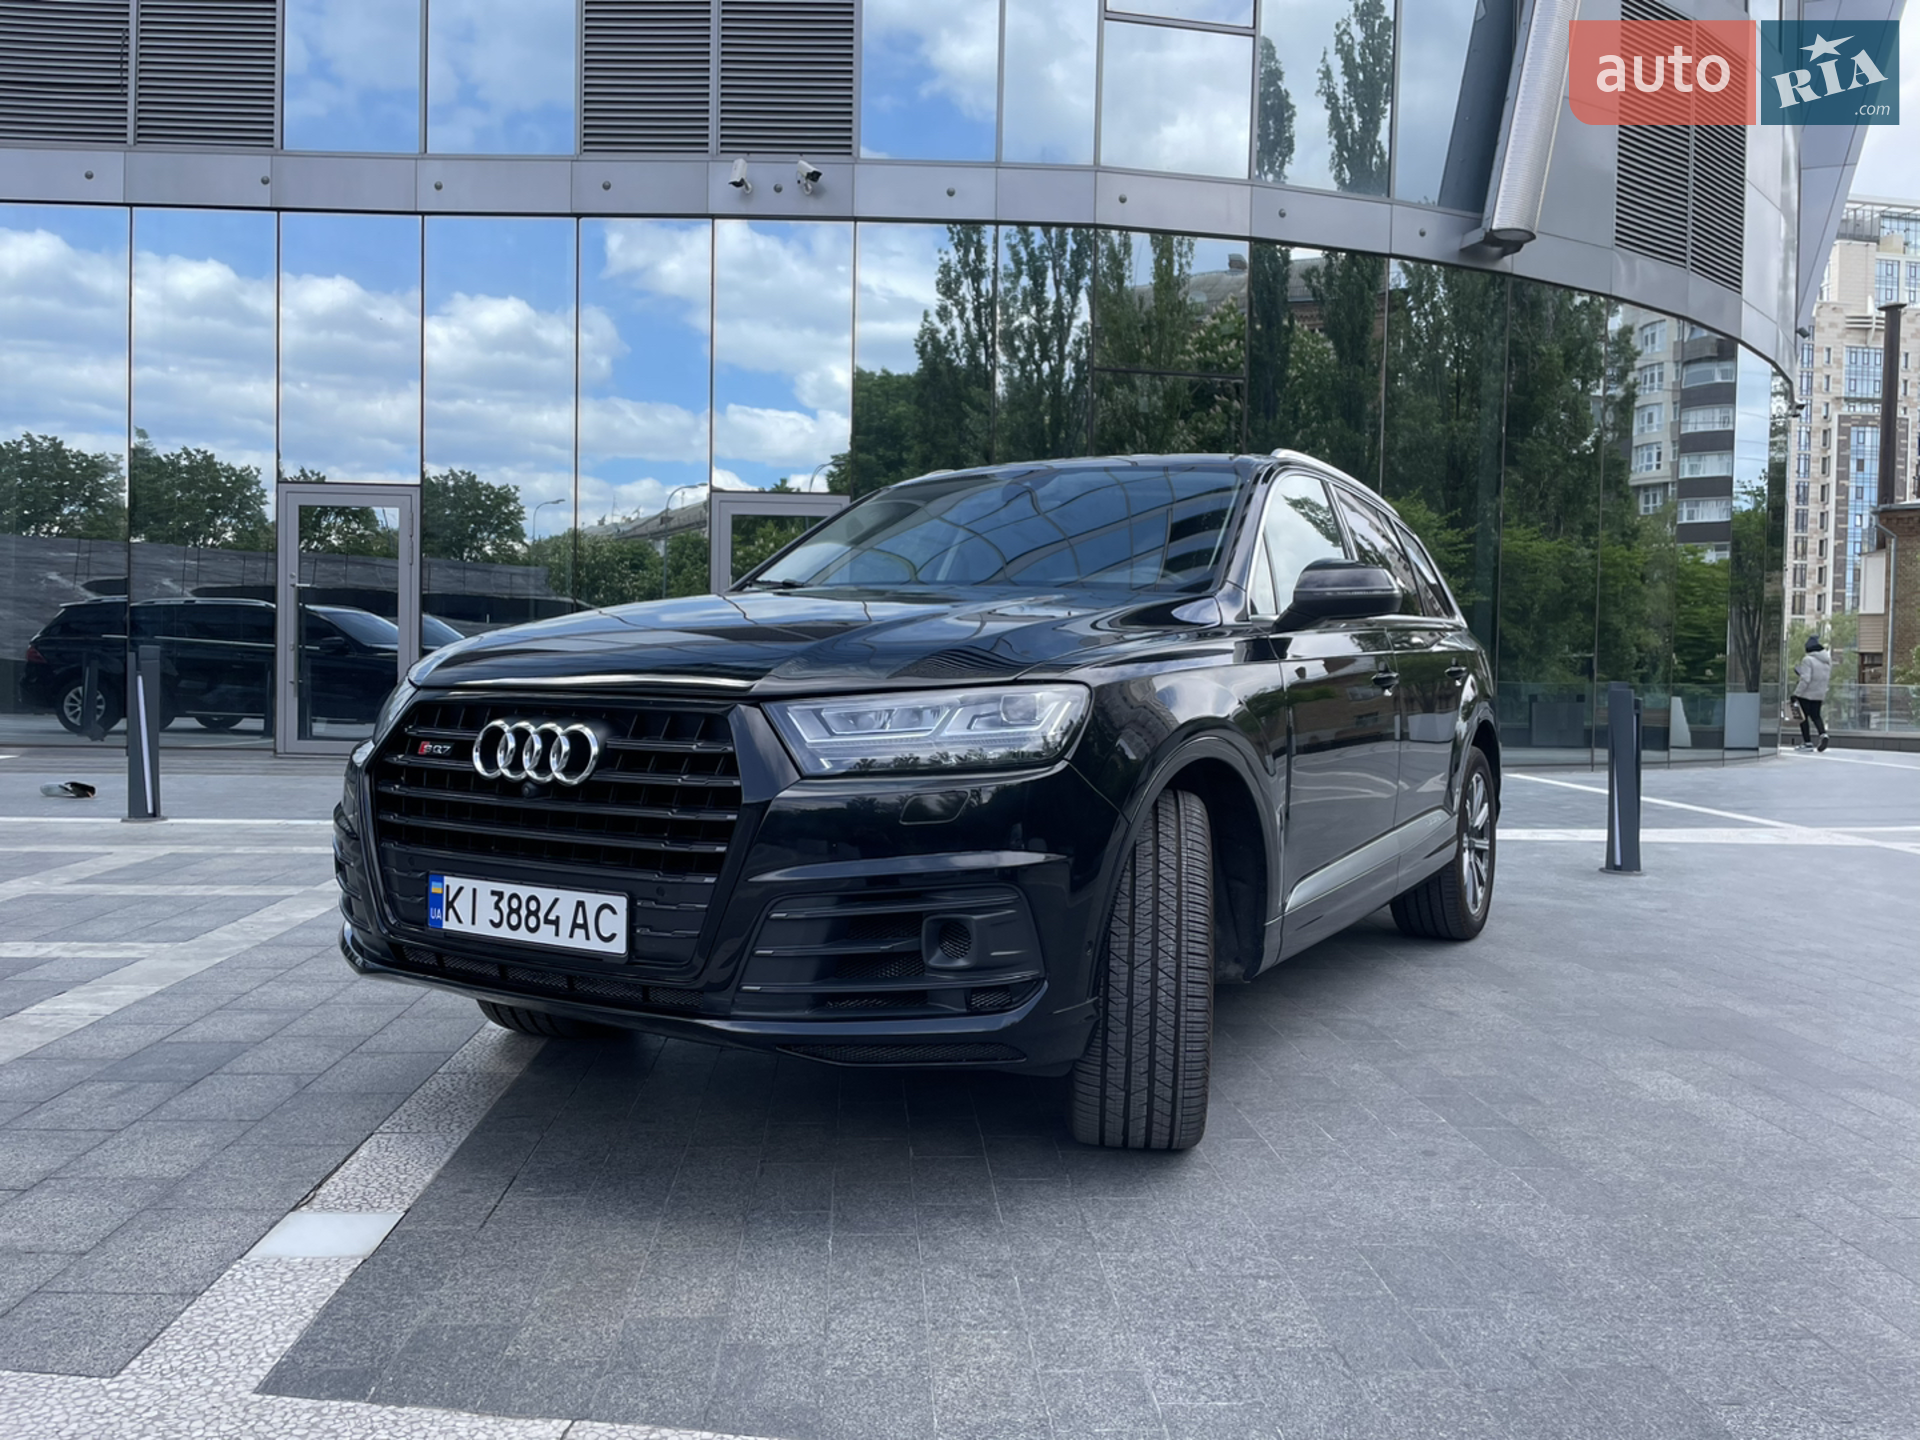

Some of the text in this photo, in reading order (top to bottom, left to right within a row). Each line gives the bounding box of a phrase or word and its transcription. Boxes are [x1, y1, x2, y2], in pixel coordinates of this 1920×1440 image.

[423, 744, 452, 755] SQ7
[430, 907, 442, 920] UA
[444, 884, 618, 943] KI 3884 AC
